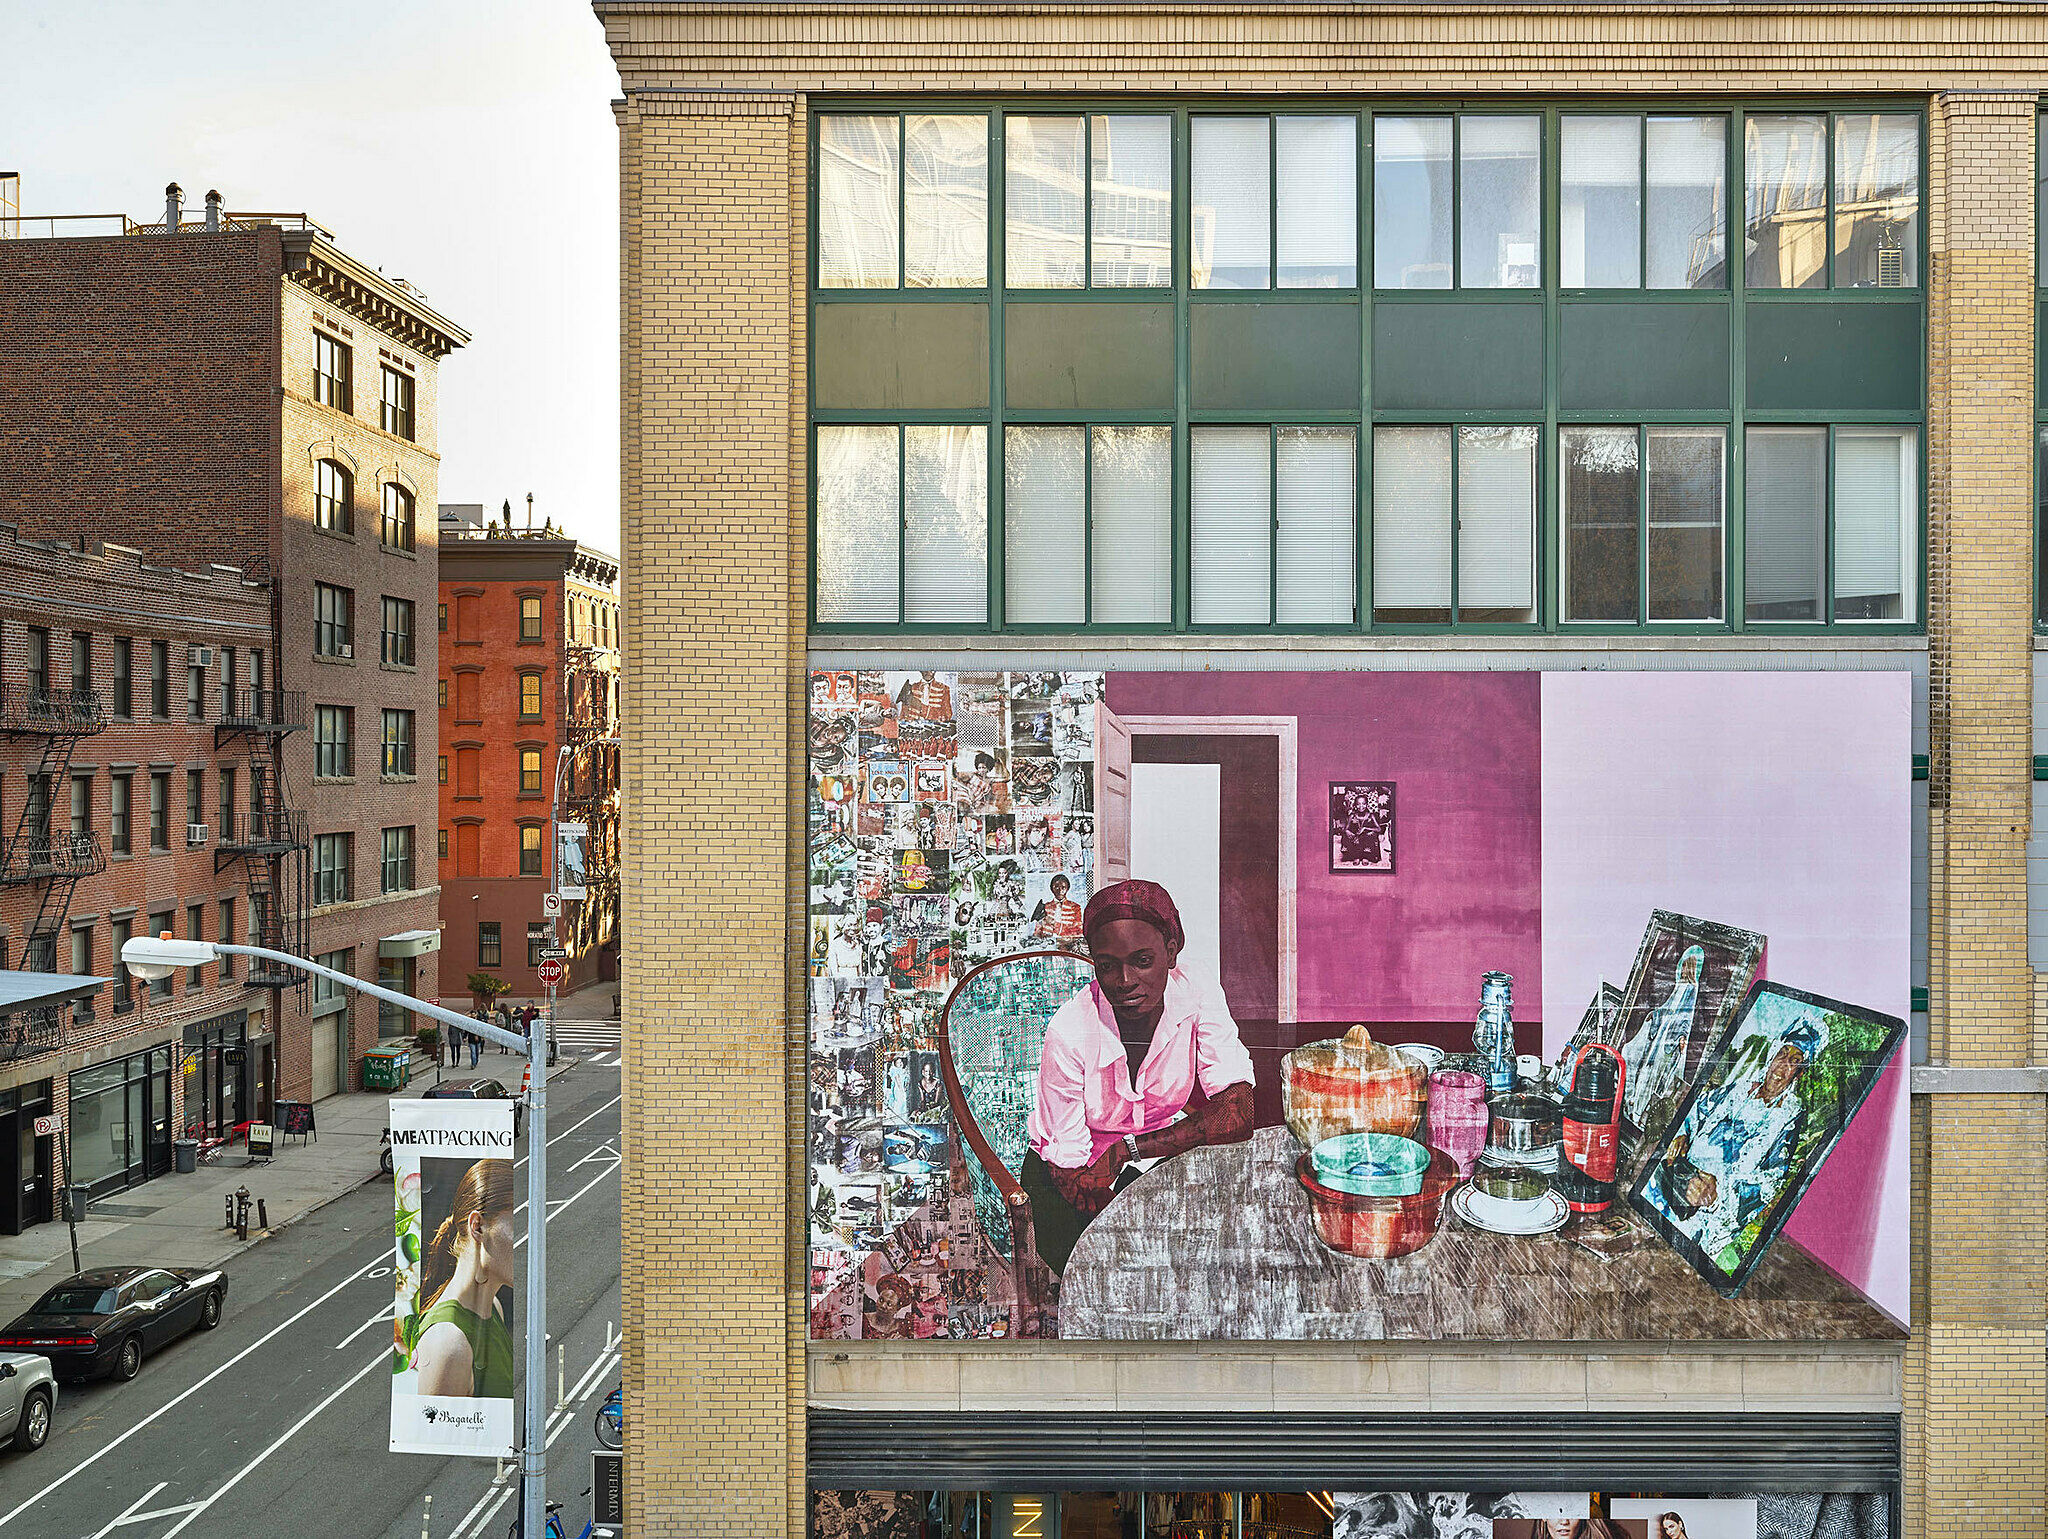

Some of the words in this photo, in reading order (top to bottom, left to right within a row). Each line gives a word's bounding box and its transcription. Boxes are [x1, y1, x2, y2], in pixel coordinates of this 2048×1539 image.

[540, 966, 560, 976] STOP
[195, 1014, 238, 1033] ESPRESSO
[227, 1052, 244, 1061] KAVA
[252, 1126, 269, 1136] KAVA
[392, 1129, 512, 1147] MEATPACKING
[439, 1410, 485, 1427] Bagatelle
[608, 1461, 619, 1518] INTERMIX
